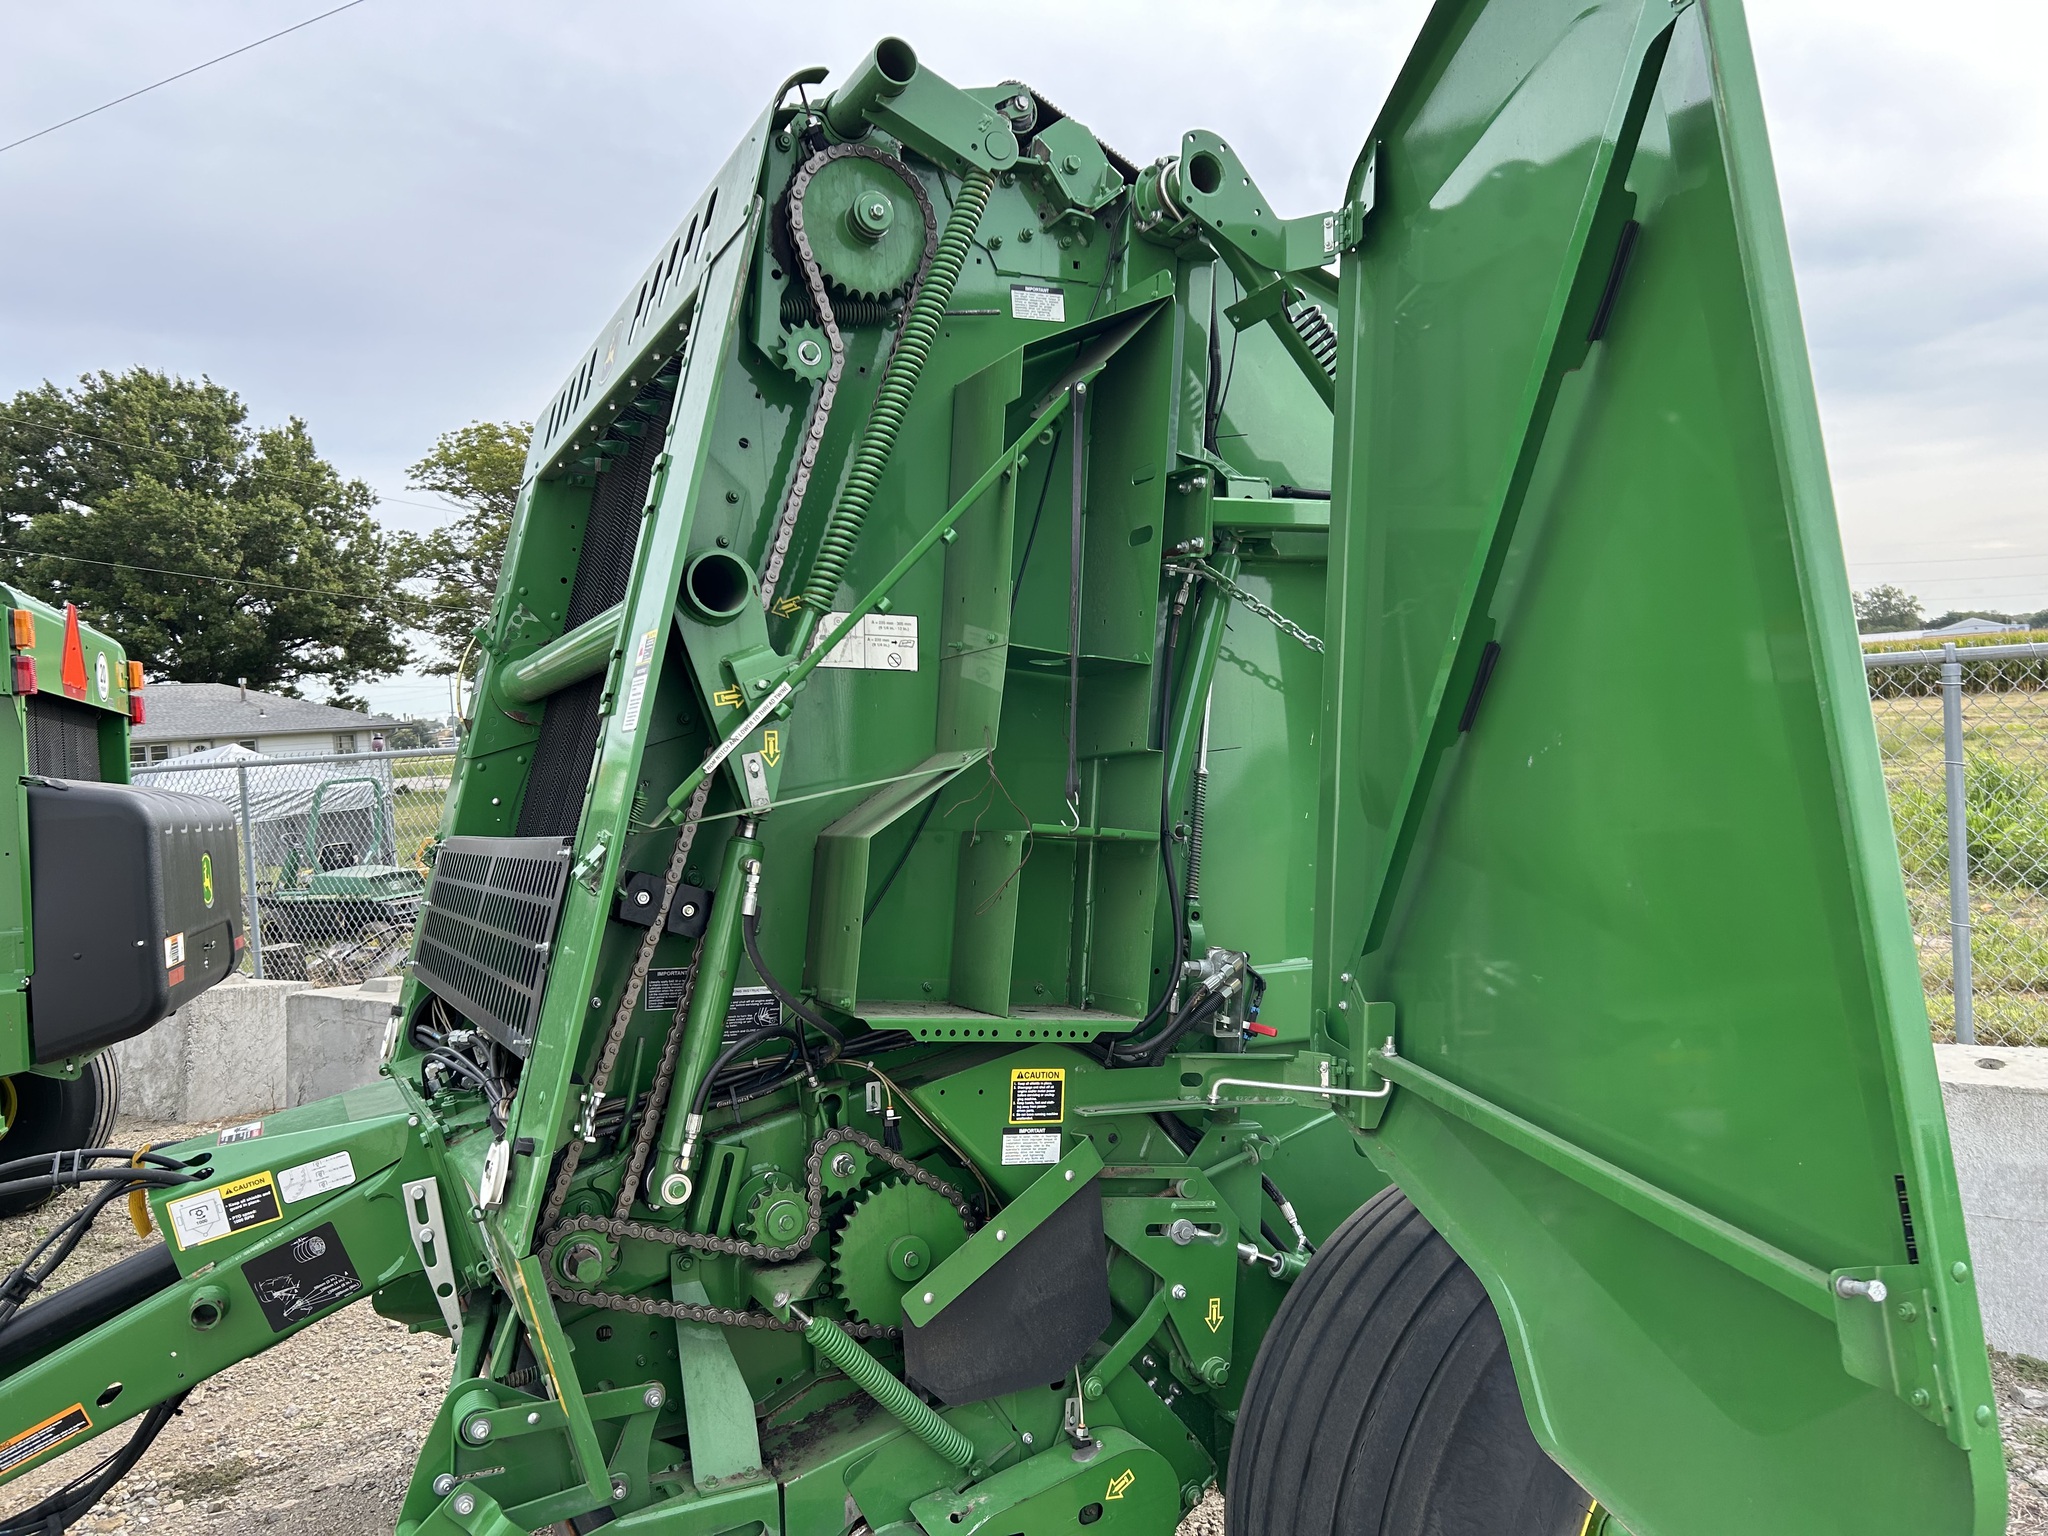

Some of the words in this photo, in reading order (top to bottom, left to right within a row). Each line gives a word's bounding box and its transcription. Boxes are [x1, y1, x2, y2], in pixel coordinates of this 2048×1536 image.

[716, 745, 730, 760] NOTCH
[739, 720, 754, 738] LOWER
[753, 715, 760, 723] TO
[760, 698, 776, 717] THREAD
[775, 685, 788, 700] TWINE
[233, 1178, 265, 1192] CAUTION
